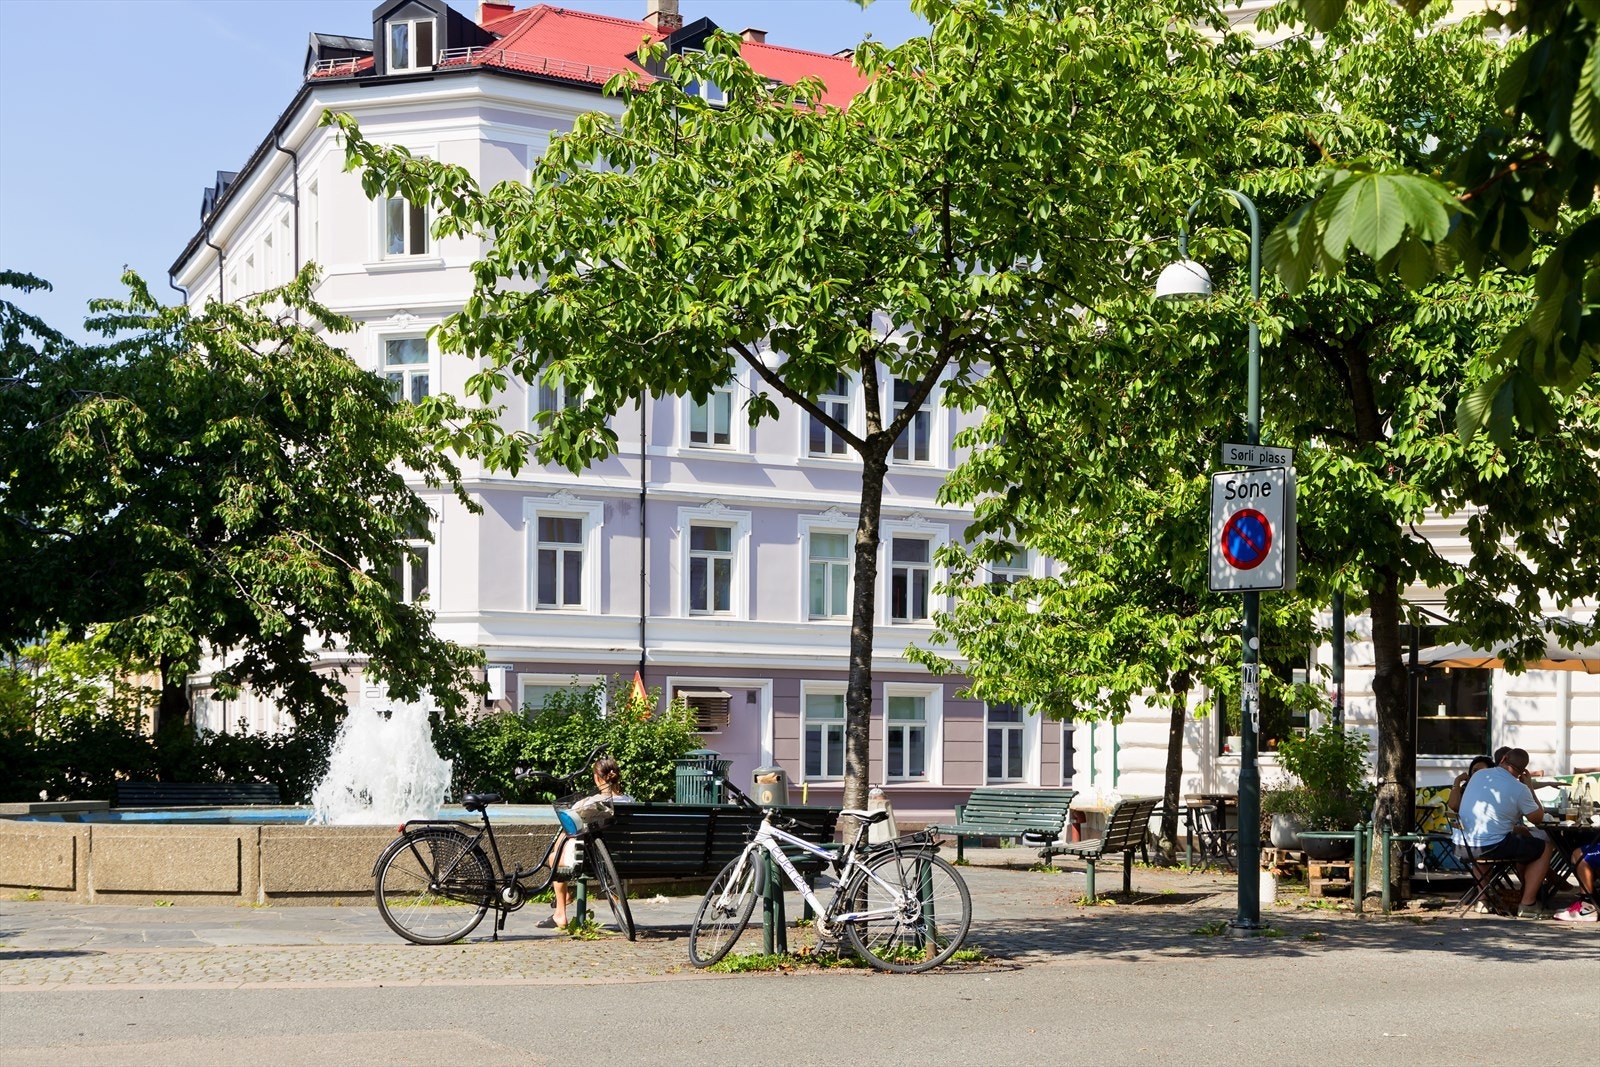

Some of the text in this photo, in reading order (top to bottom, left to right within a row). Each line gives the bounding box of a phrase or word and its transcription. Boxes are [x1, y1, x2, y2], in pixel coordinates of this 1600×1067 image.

[1230, 448, 1286, 465] Sørli plass
[1225, 480, 1272, 500] Sone
